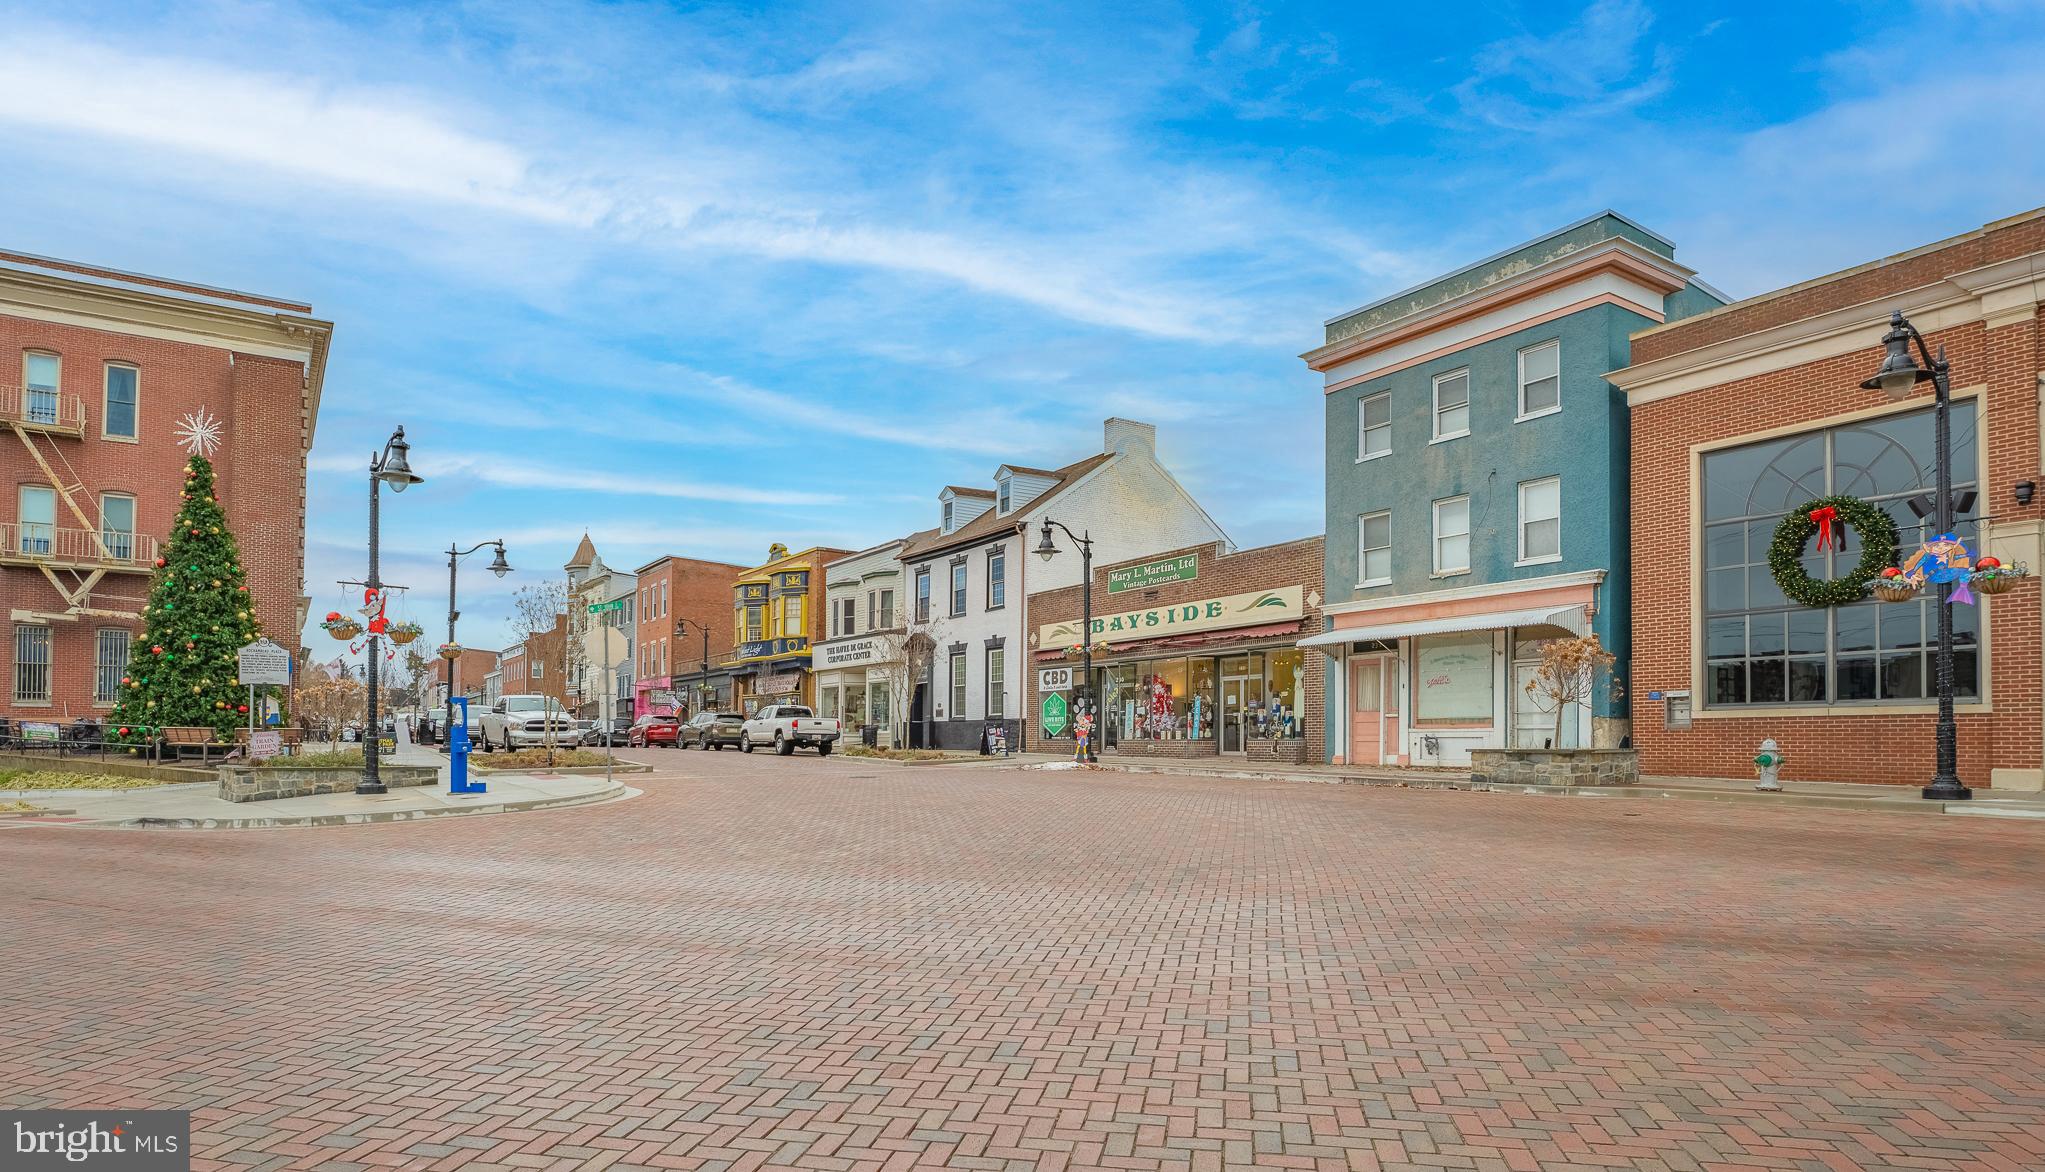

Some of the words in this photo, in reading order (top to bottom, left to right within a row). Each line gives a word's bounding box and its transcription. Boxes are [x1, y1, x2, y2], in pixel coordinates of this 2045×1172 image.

[1111, 570, 1131, 583] Mary
[1134, 569, 1141, 578] L.
[1144, 562, 1176, 576] Martin,
[1179, 557, 1194, 570] Ltd
[1123, 579, 1147, 589] Vintage
[1148, 573, 1181, 584] Postcards
[1090, 601, 1223, 634] BAYSIDE
[826, 647, 835, 655] THE
[836, 645, 849, 653] HAVRE
[857, 641, 872, 650] GRACE
[828, 653, 852, 663] CORPORATE
[853, 651, 871, 660] CENTER
[1043, 670, 1068, 686] CBD
